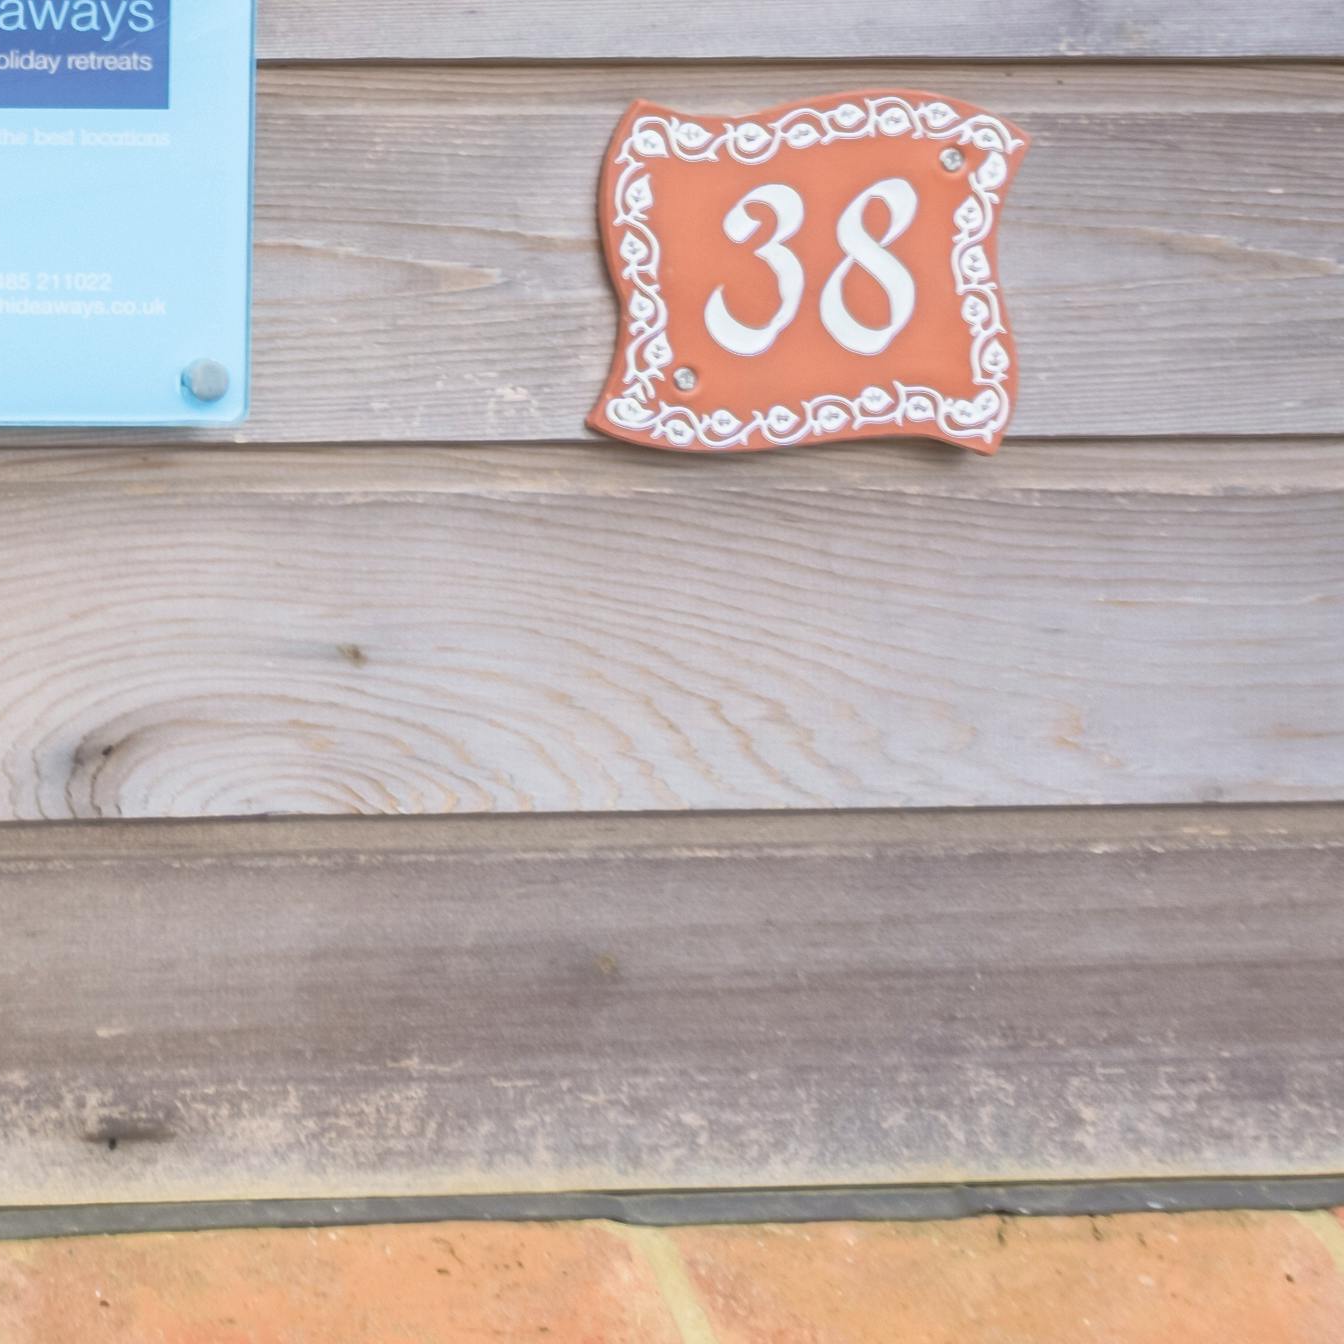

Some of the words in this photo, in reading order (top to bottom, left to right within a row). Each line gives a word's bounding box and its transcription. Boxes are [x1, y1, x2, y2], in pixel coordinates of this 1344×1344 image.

[66, 52, 154, 72] retreats
[32, 127, 76, 146] best
[79, 128, 171, 147] locations
[704, 177, 918, 356] 38
